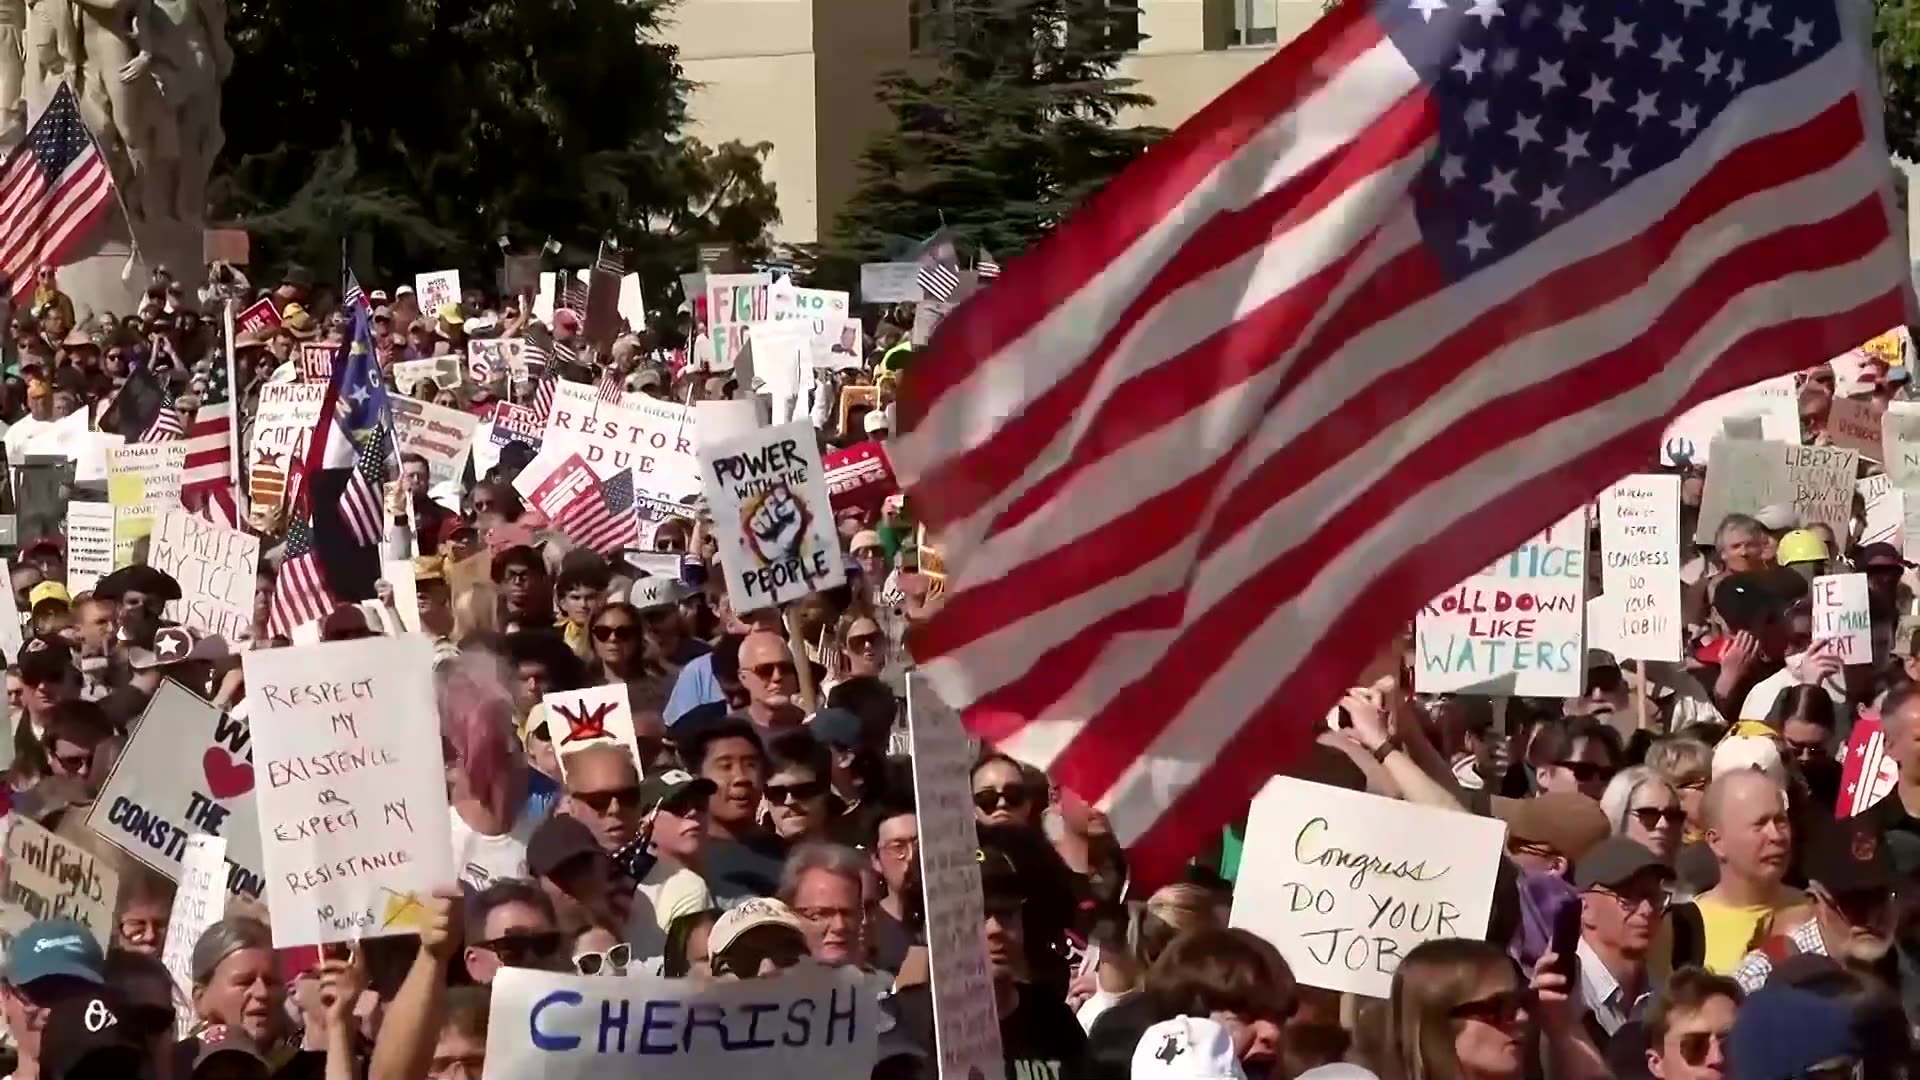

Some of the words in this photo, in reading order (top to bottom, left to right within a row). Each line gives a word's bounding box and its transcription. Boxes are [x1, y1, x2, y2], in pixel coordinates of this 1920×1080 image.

[796, 294, 824, 309] NO
[114, 447, 159, 459] DONALD
[586, 444, 655, 474] DUE
[712, 438, 808, 488] POWER
[1785, 448, 1853, 469] LIBERTY
[733, 480, 772, 500] WITH
[777, 467, 809, 486] THE
[160, 513, 169, 543] I
[153, 543, 188, 581] MY
[742, 550, 831, 597] PEOPLE
[1607, 551, 1669, 568] CONGRESS
[195, 557, 236, 606] ICE
[1629, 577, 1645, 589] DO
[1495, 590, 1576, 614] DOWN
[1624, 595, 1656, 613] YOUR
[1469, 617, 1536, 638] LIKE
[1421, 632, 1578, 675] WATERS
[261, 678, 375, 712] RESPECT
[214, 711, 255, 764] W
[330, 711, 358, 739] MY
[267, 745, 400, 788] EXISTENCE
[317, 788, 350, 805] OR
[184, 790, 231, 837] THE
[273, 810, 360, 842] EXPECT
[383, 797, 414, 833] MY
[1294, 817, 1451, 890] Congress
[285, 850, 409, 896] RESISTANCE
[316, 904, 335, 924] NO
[333, 908, 376, 931] KINGS
[1282, 881, 1336, 915] DO
[1367, 894, 1461, 937] YOUR
[529, 983, 857, 1056] CHERISH
